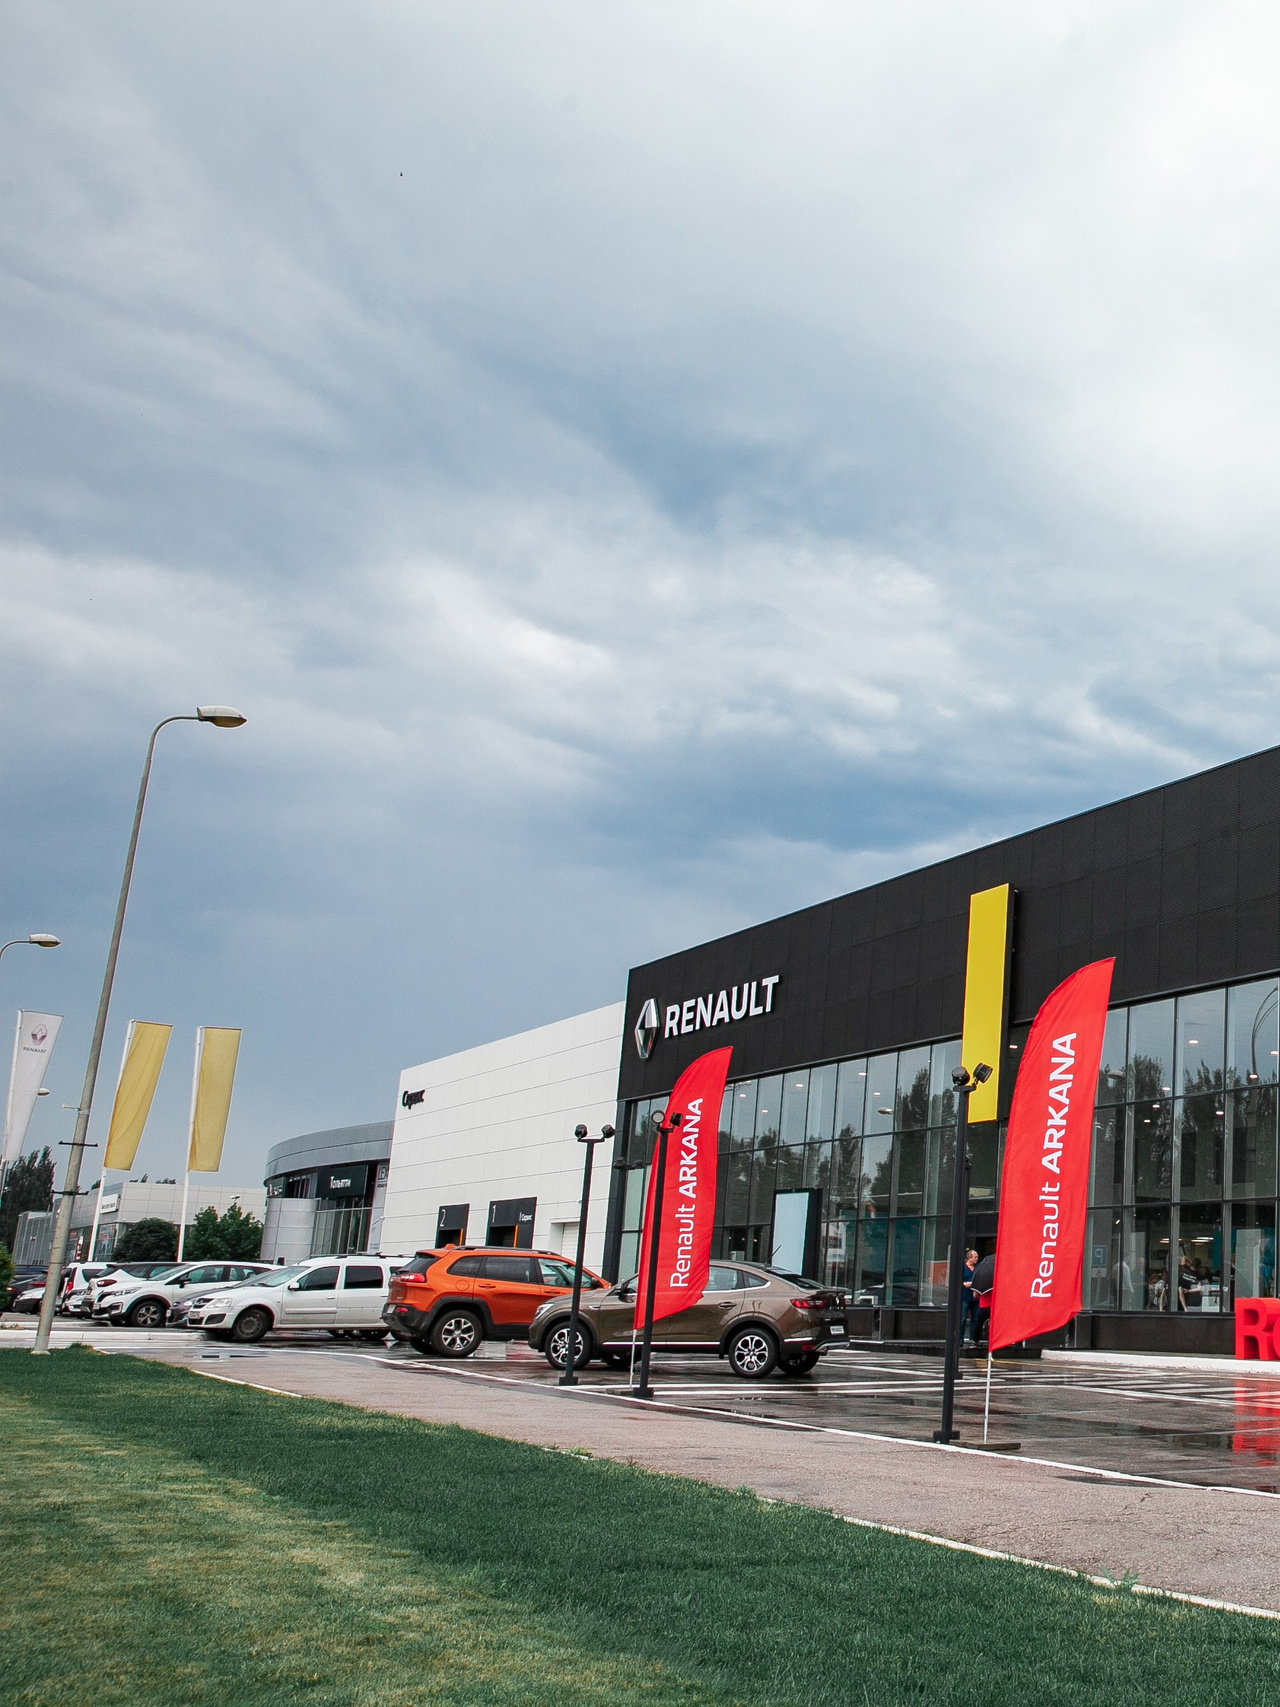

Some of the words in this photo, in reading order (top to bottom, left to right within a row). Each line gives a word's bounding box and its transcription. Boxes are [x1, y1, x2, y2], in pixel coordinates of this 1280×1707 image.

[664, 974, 780, 1038] RENAULT
[1041, 1032, 1077, 1175] ARKANA
[678, 1097, 704, 1199] ARKANA
[440, 1209, 446, 1227] 2
[492, 1204, 497, 1223] 1
[669, 1203, 696, 1288] Renault
[1030, 1181, 1060, 1299] Renault
